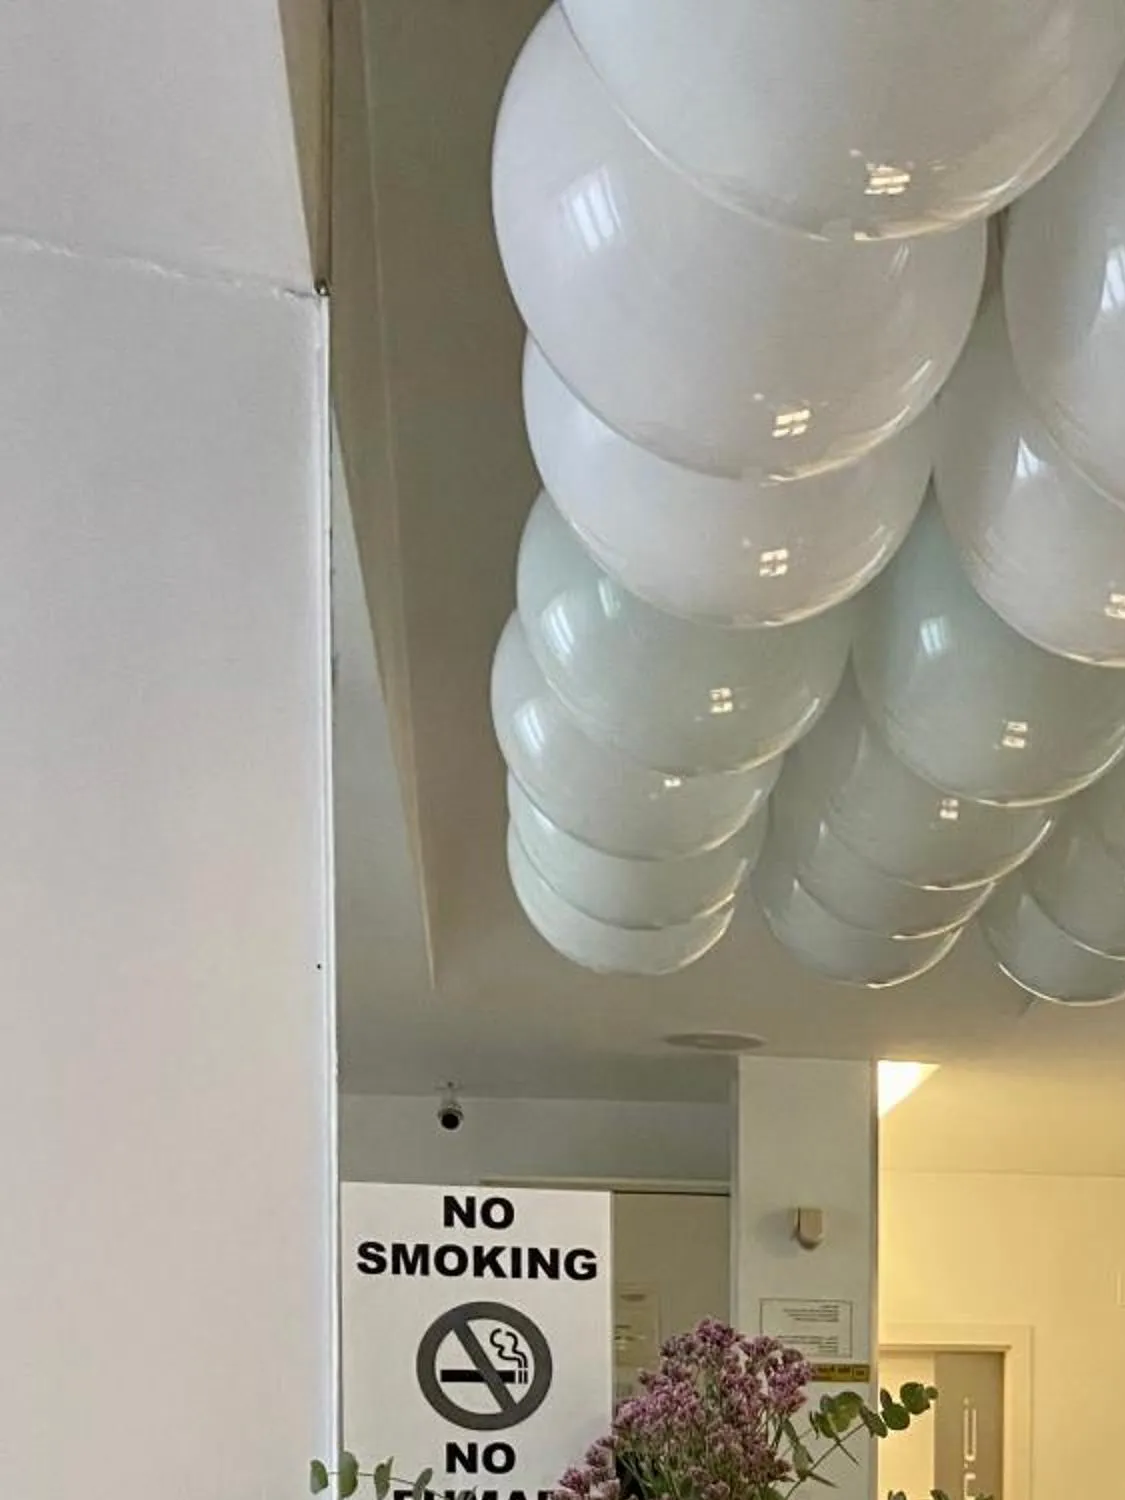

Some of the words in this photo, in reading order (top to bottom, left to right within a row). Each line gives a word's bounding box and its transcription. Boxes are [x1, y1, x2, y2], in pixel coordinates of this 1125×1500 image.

[443, 1195, 516, 1230] NO
[356, 1241, 598, 1281] SMOKING
[445, 1442, 516, 1474] NO
